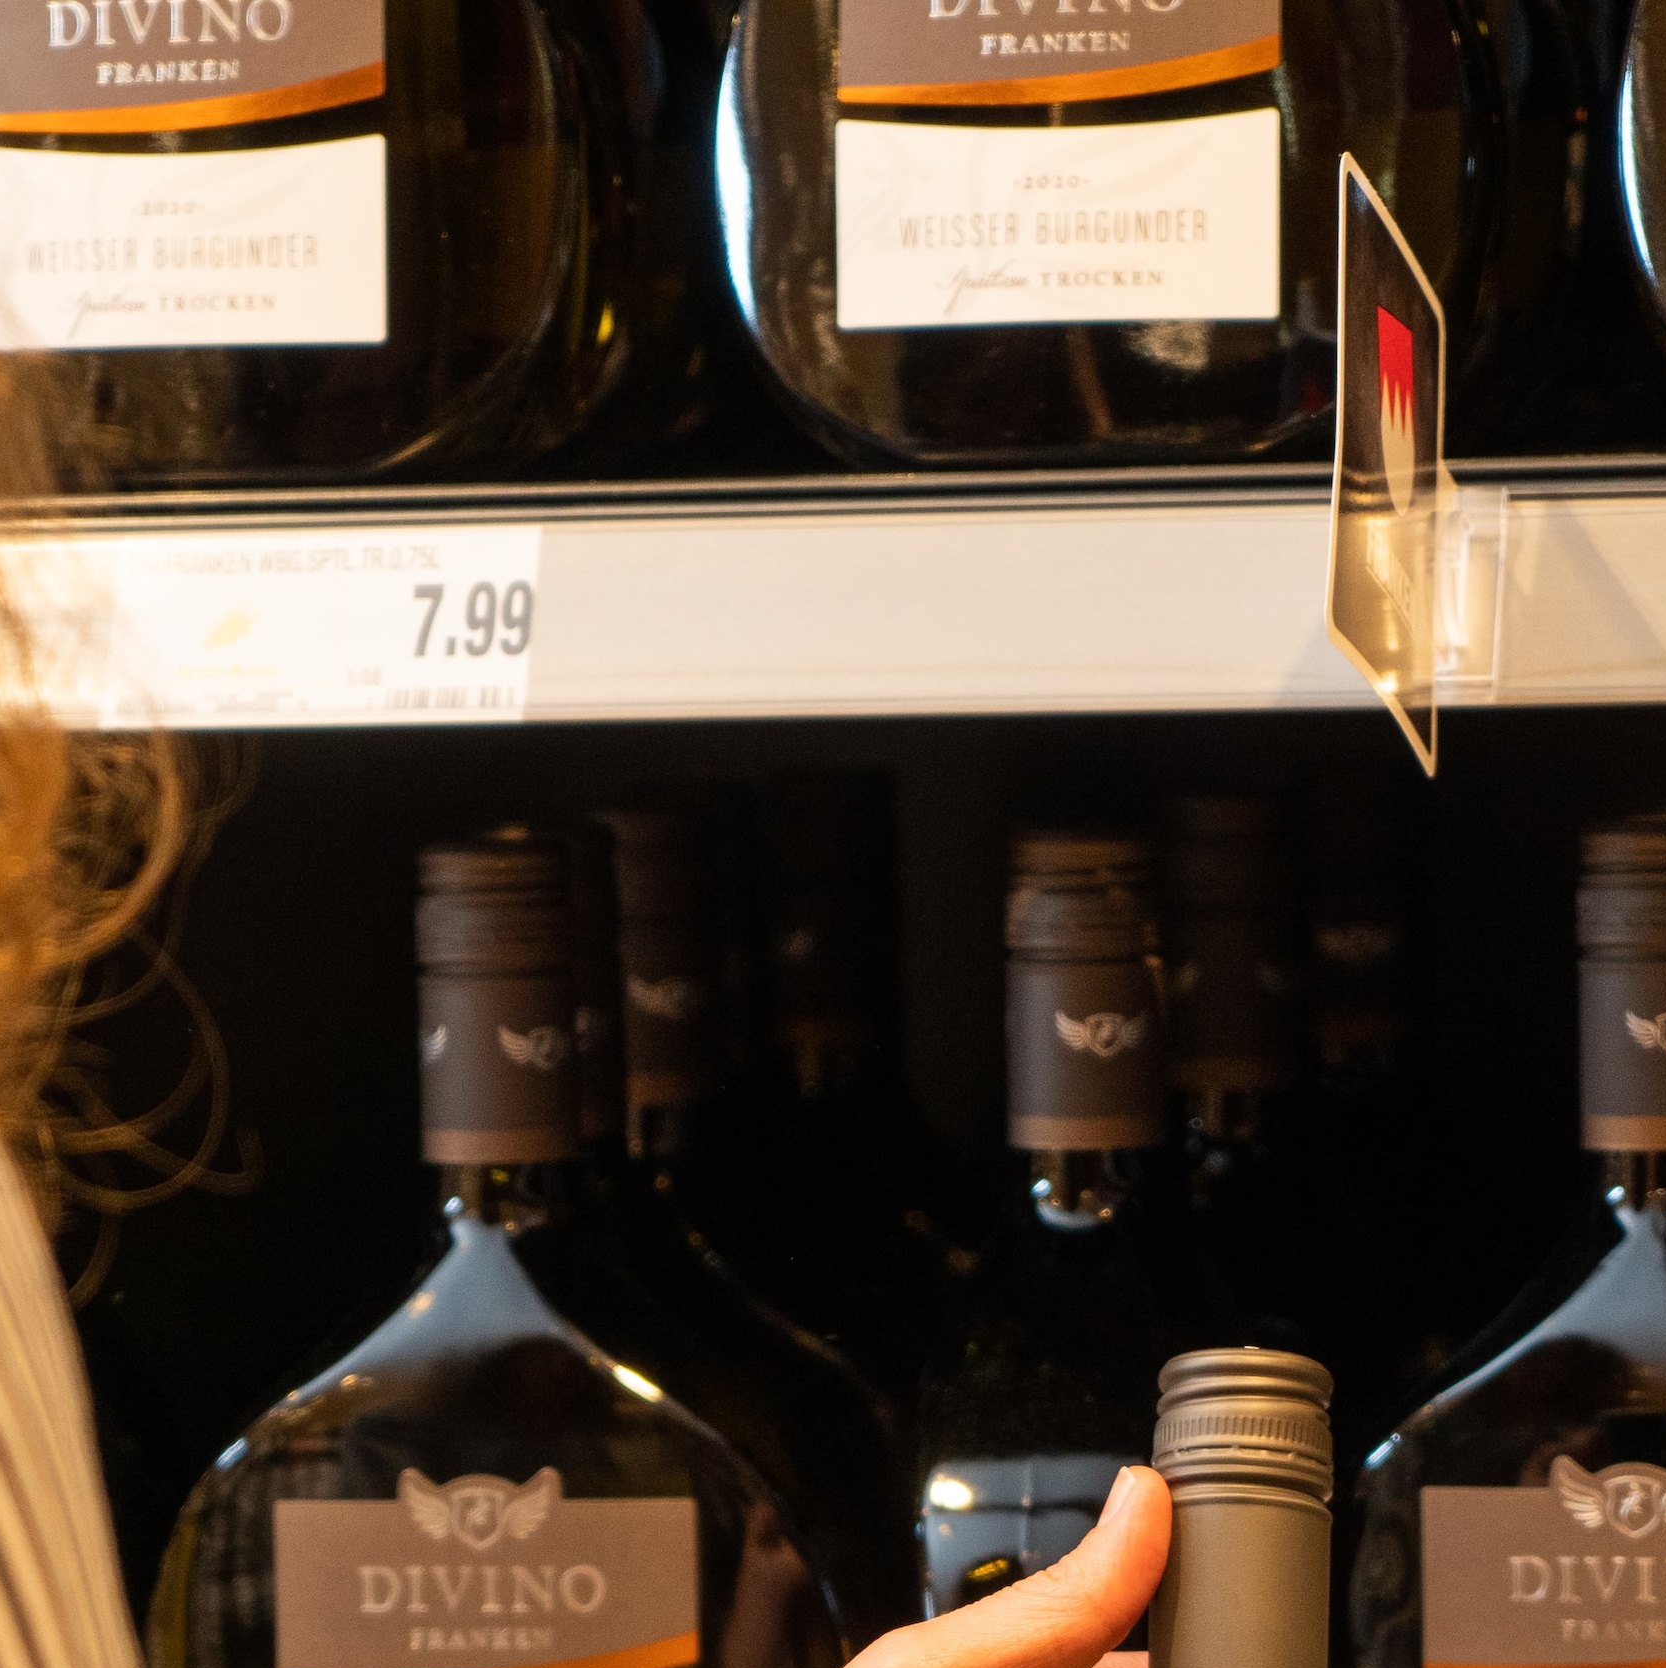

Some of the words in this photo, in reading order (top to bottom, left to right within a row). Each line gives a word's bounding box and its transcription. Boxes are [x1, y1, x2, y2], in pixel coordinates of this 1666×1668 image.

[48, 0, 291, 48] DIVINO
[980, 31, 1131, 56] FRANKEN
[96, 59, 240, 86] FRANKEN
[899, 212, 1023, 250] WEISSER
[1036, 209, 1209, 246] BURGUNDER
[26, 236, 138, 276] WEISSER
[153, 233, 321, 273] BURGUNDER
[1040, 270, 1165, 290] TROCKEN
[158, 294, 277, 313] TROCKEN
[413, 580, 533, 658] 7.99
[358, 1564, 607, 1613] DIVINO
[410, 1627, 554, 1650] FRANKEN
